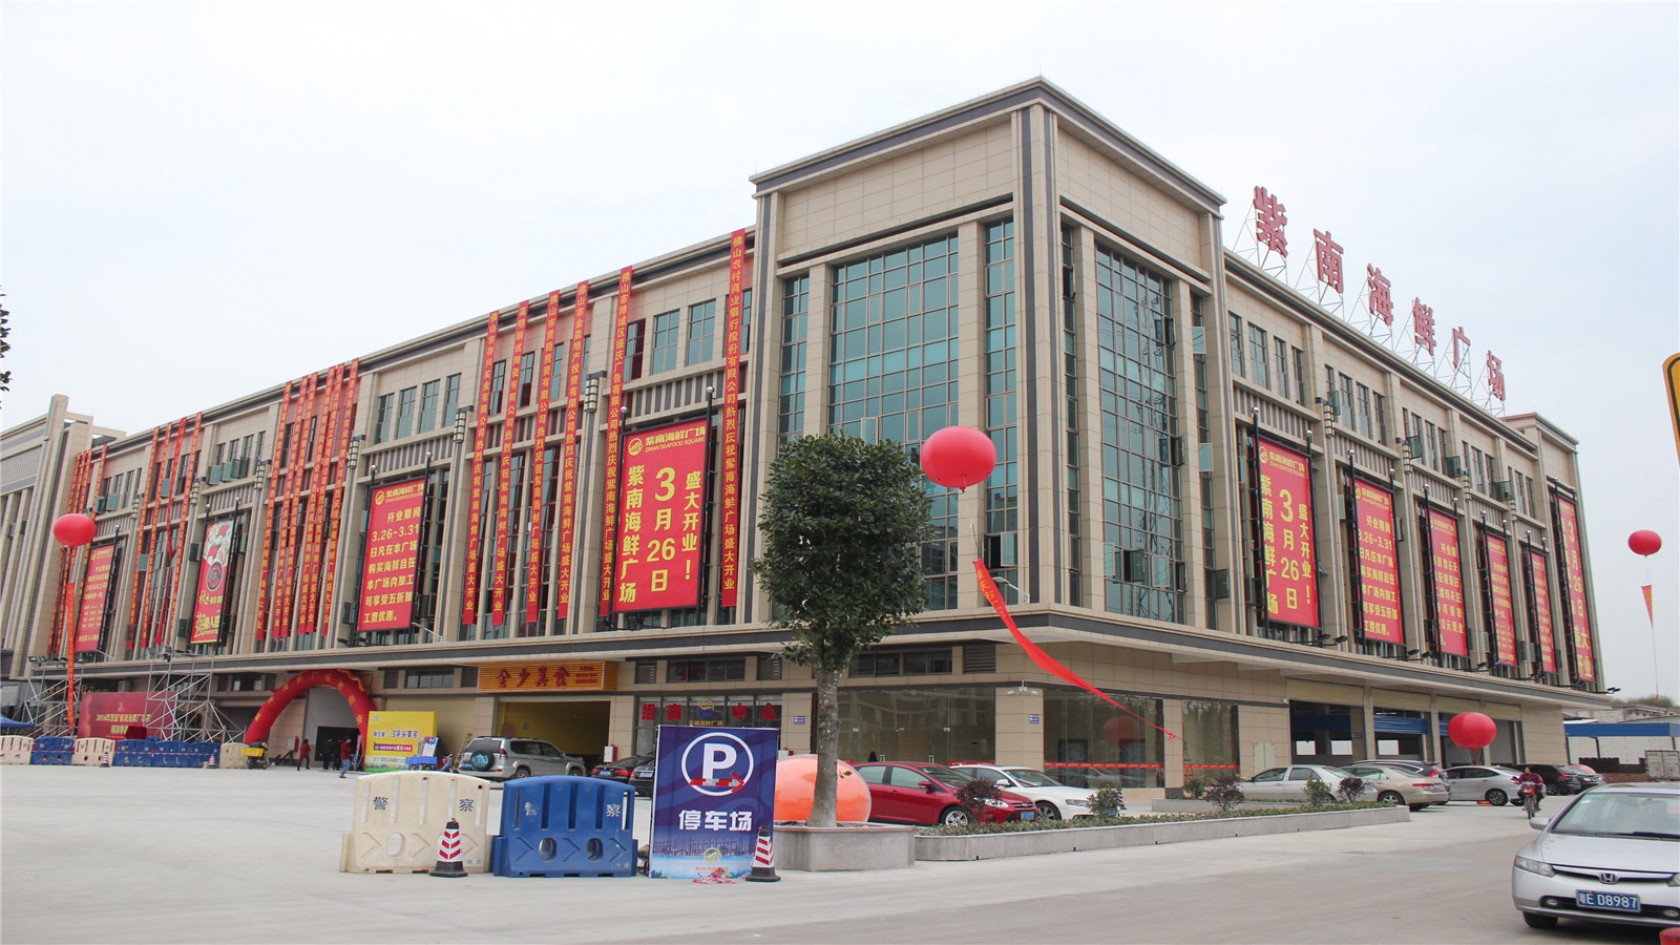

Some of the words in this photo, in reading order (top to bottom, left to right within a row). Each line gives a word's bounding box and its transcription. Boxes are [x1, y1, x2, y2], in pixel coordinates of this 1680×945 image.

[1253, 185, 1506, 401] 紫南海鲜广场
[646, 426, 706, 446] 紫南海鲜广场
[619, 464, 645, 603] 紫南海鲜广场
[702, 743, 737, 781] P
[679, 810, 752, 831] 停车场
